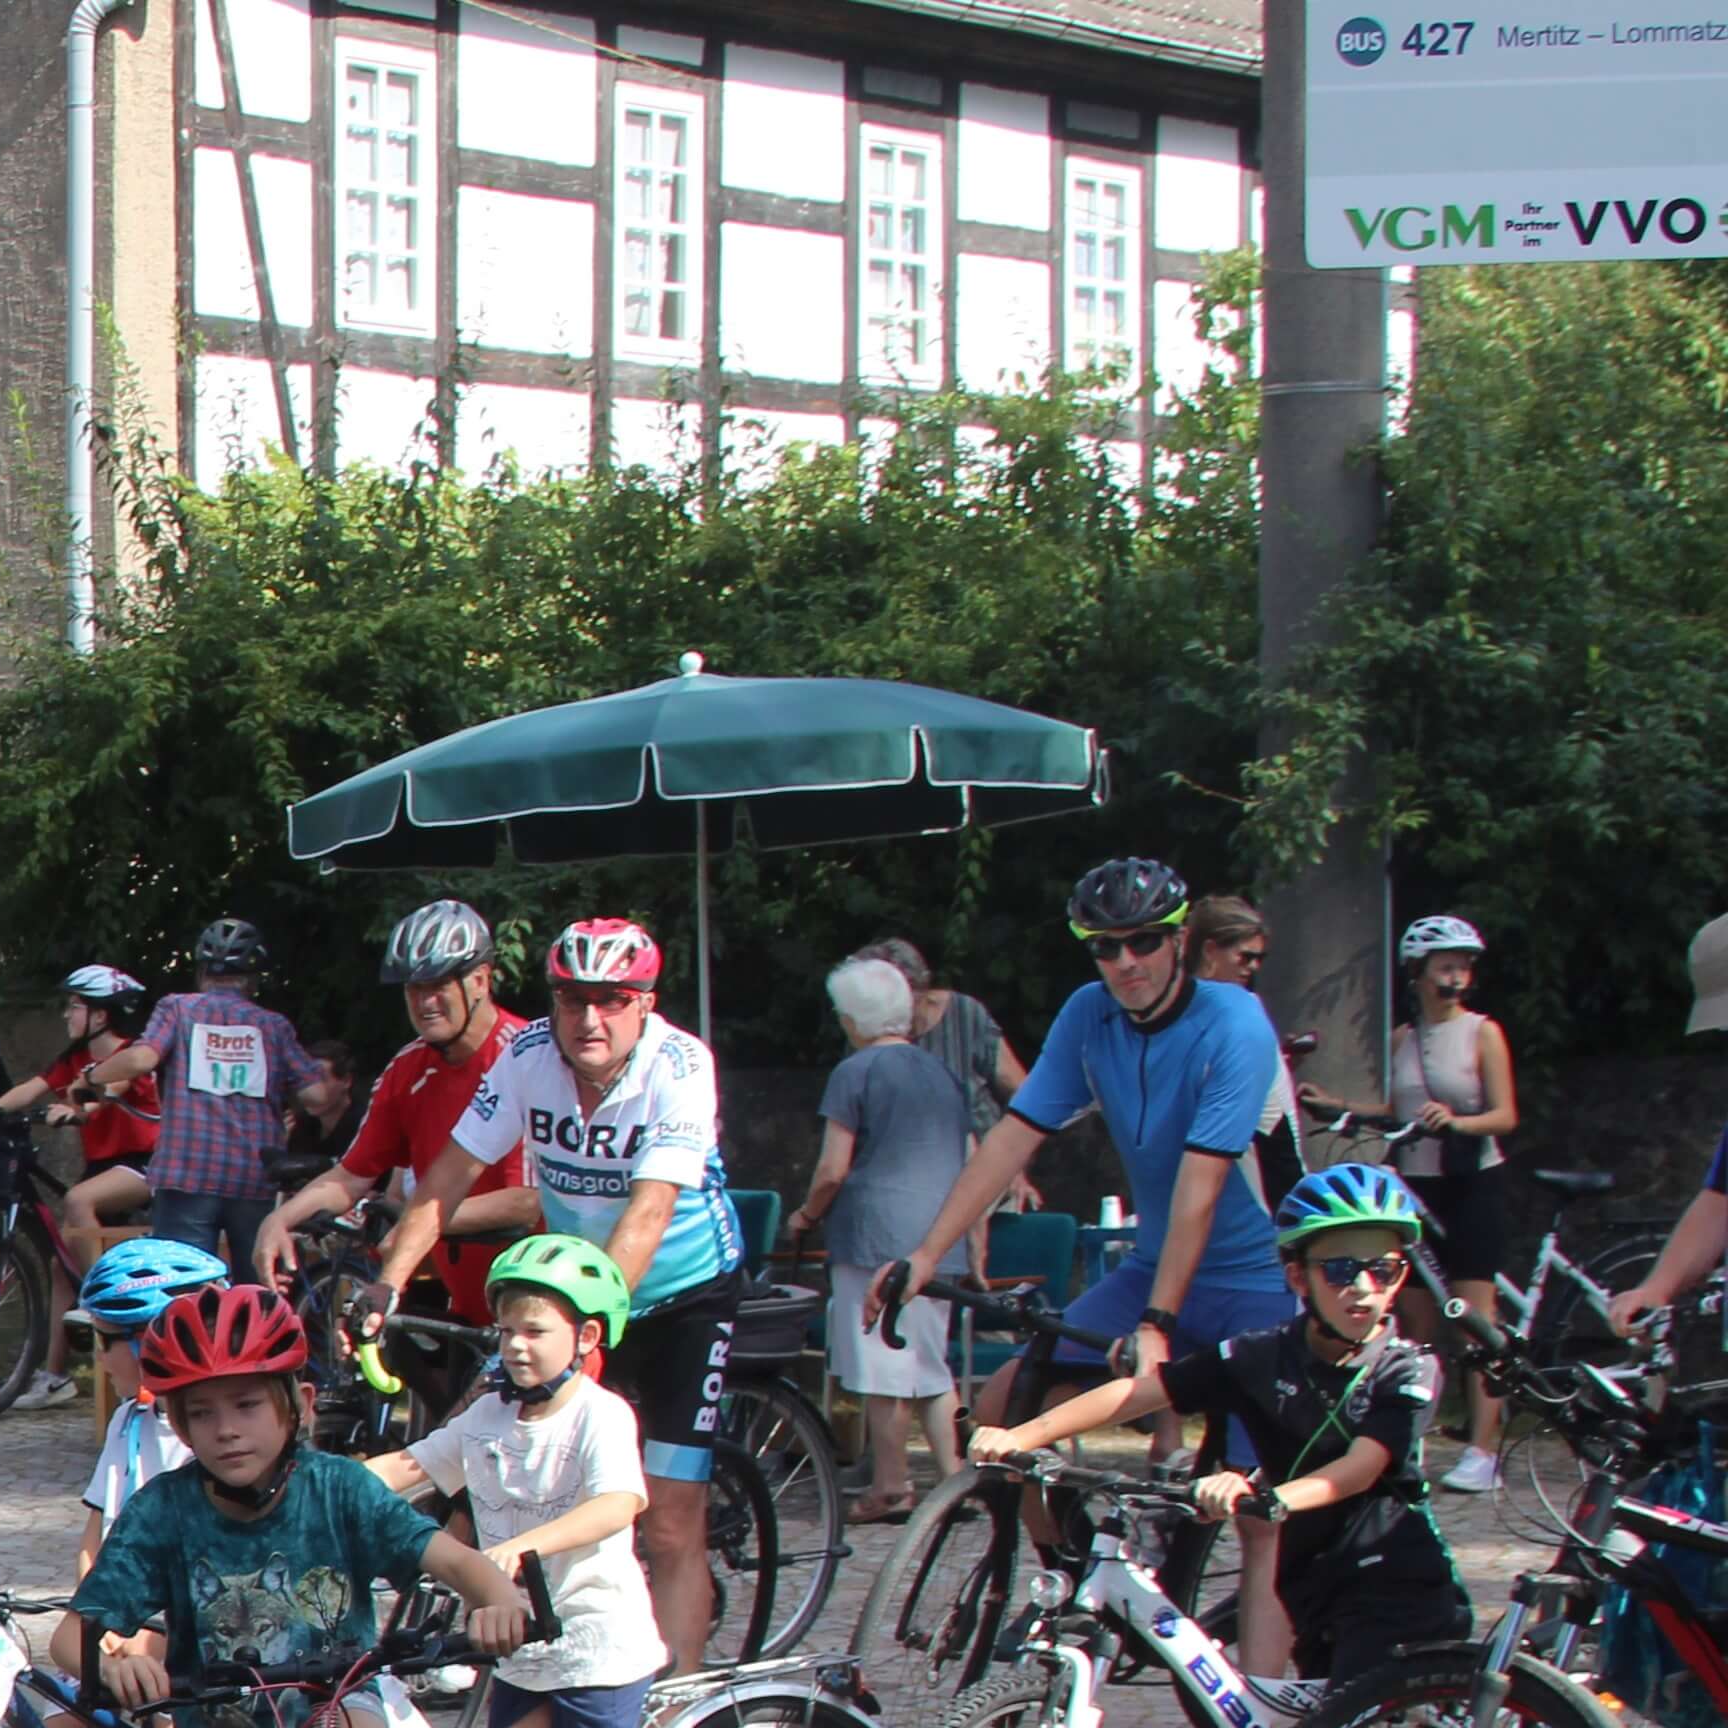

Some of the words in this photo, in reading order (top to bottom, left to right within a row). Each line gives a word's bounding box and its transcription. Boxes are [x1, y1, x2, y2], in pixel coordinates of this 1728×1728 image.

[1340, 31, 1384, 53] BUS
[1401, 22, 1475, 56] 427
[1497, 26, 1581, 48] Mertitz
[1522, 203, 1543, 215] Ihr
[1344, 204, 1495, 251] VGM
[1505, 219, 1561, 232] Partner
[1564, 198, 1707, 246] VVO
[1522, 235, 1542, 247] im
[207, 1033, 255, 1050] Brot
